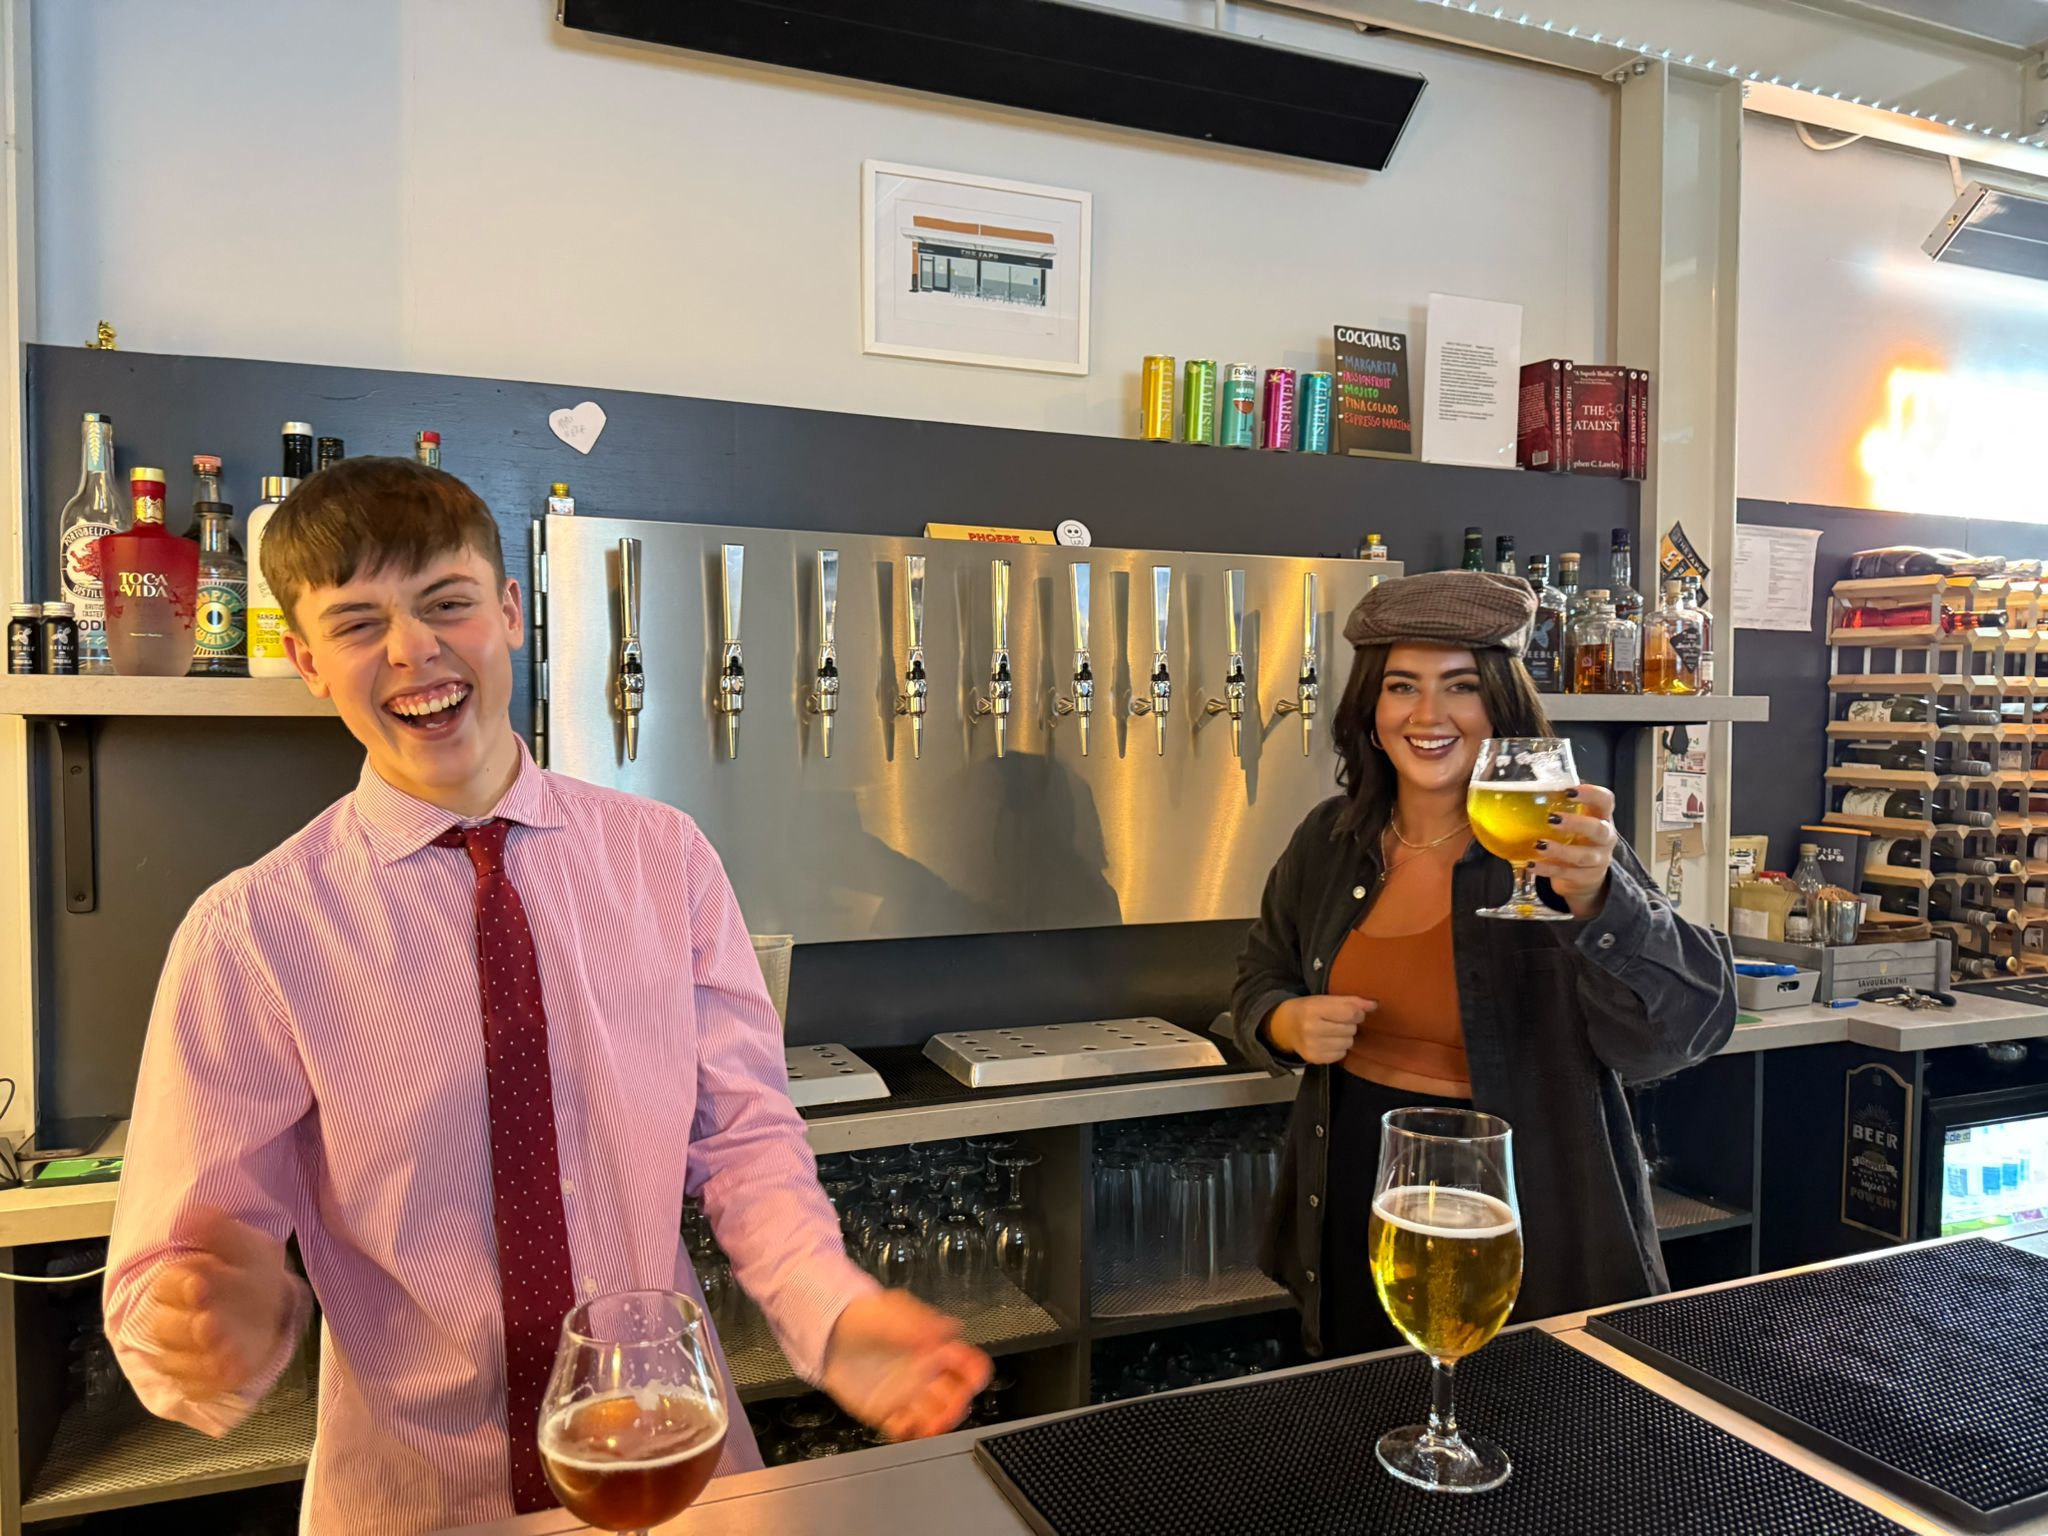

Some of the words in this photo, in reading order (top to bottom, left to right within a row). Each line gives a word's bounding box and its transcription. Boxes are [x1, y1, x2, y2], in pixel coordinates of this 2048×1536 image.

[1337, 328, 1402, 351] COCKTAILS
[1344, 355, 1399, 376] MARGARITA
[1161, 364, 1173, 422] SERVED
[1201, 369, 1214, 424] SERVED
[1344, 384, 1379, 398] MOJITO
[1282, 377, 1294, 432] SERVED
[1315, 380, 1327, 435] SERVED
[1582, 404, 1605, 416] THE
[1344, 412, 1381, 428] ESPRESSO
[1574, 420, 1620, 431] ATALYST
[1573, 460, 1590, 469] phen
[64, 526, 110, 546] PORTOBELLO
[968, 532, 1021, 544] PHOEBE
[119, 572, 168, 586] TOCA
[73, 585, 104, 598] DISTILL
[119, 584, 168, 598] VIDA
[196, 590, 241, 609] UPPY
[1527, 650, 1559, 658] EEBLE
[1817, 854, 1845, 862] APS
[1852, 1124, 1898, 1150] BEER
